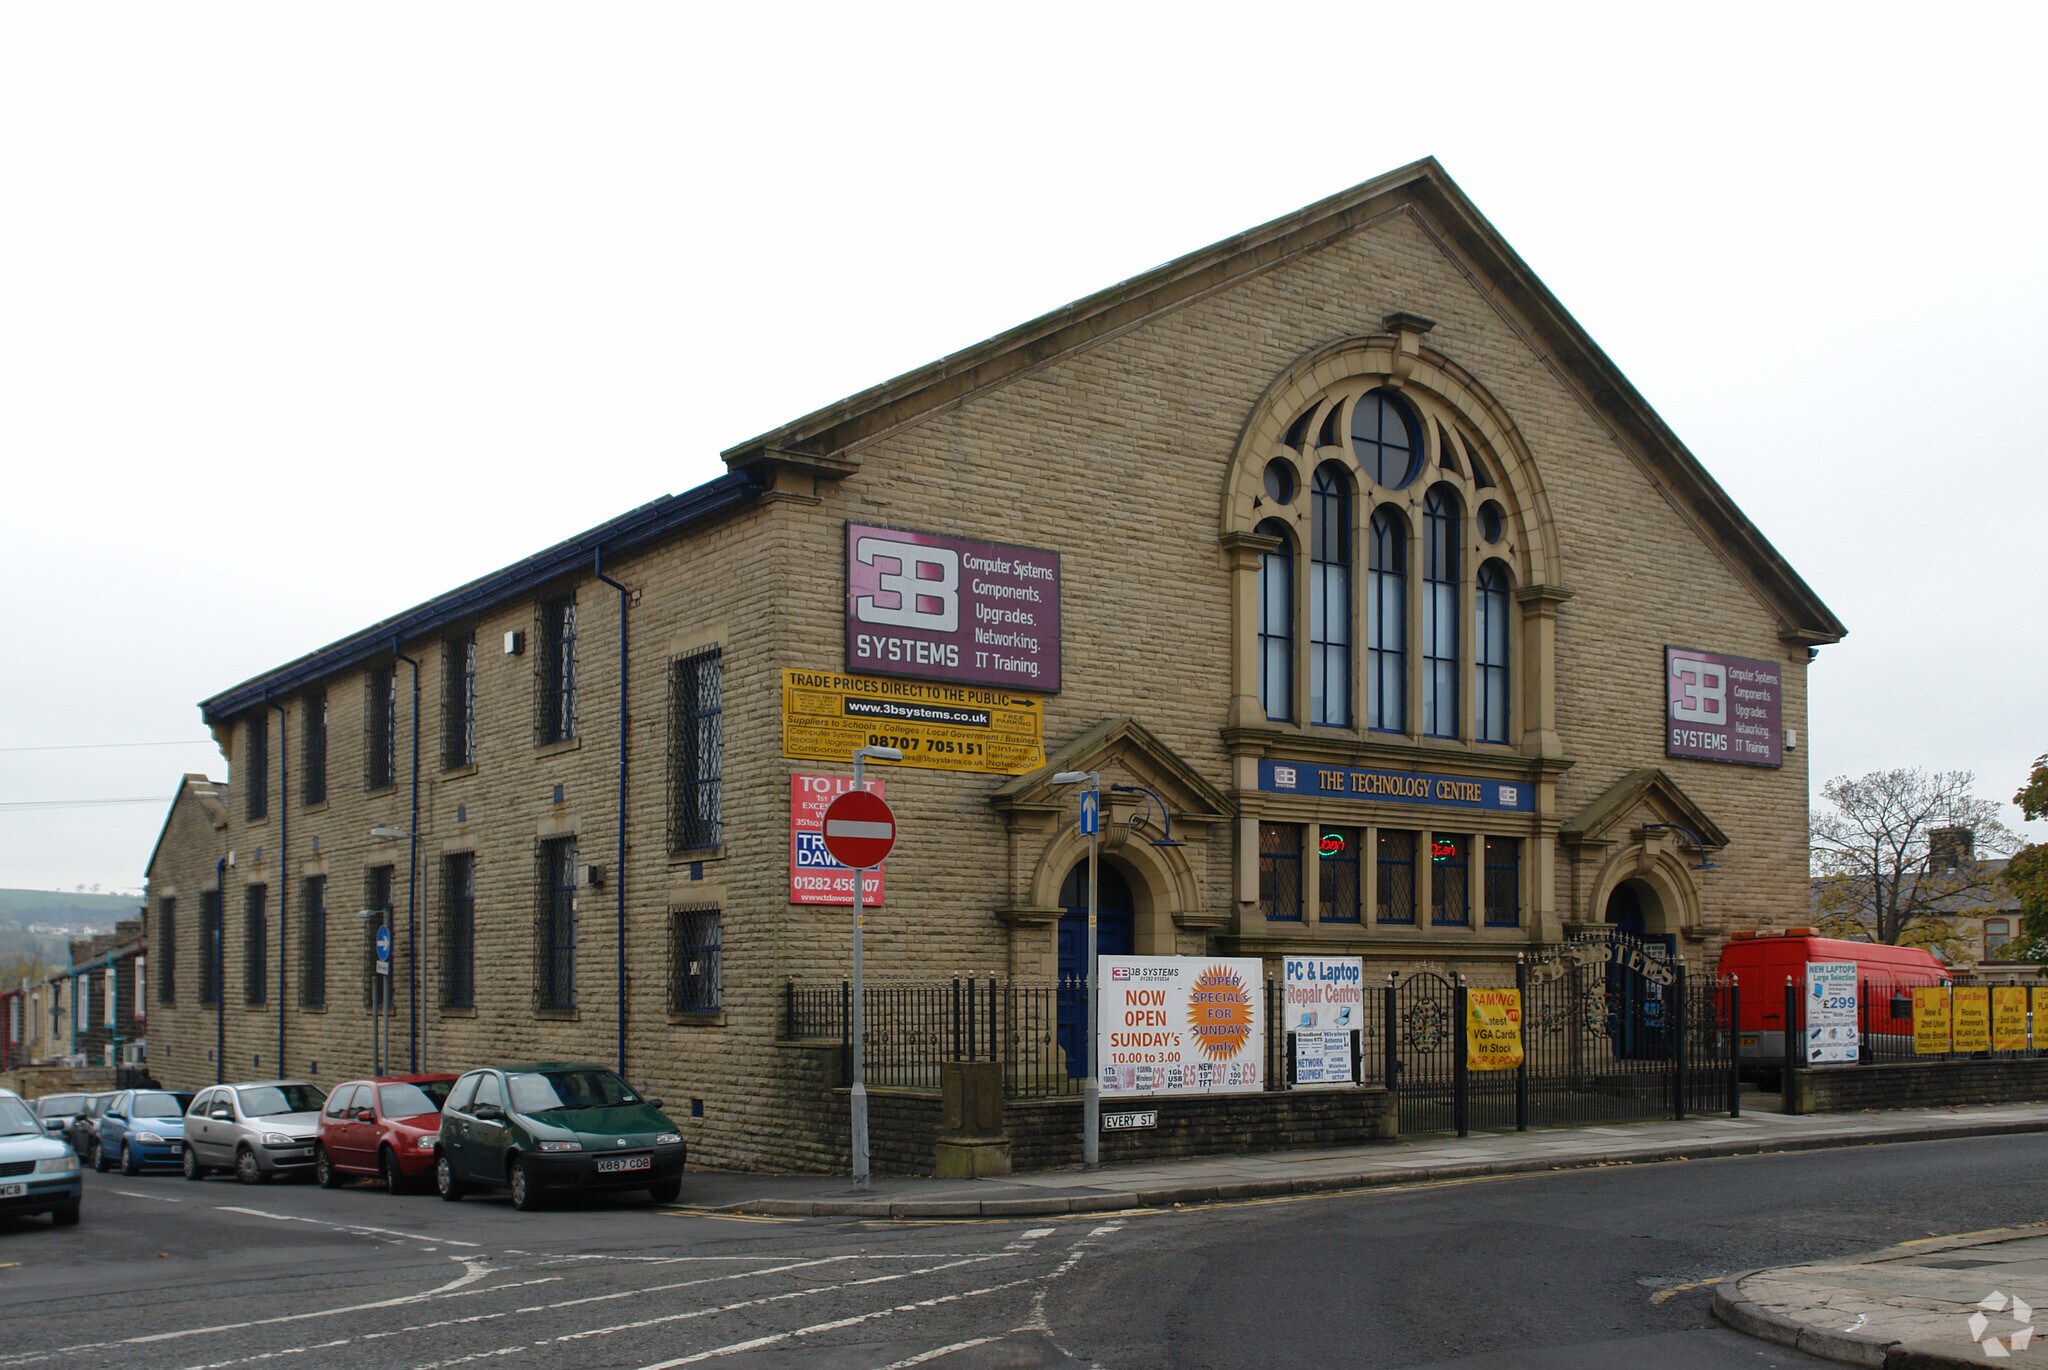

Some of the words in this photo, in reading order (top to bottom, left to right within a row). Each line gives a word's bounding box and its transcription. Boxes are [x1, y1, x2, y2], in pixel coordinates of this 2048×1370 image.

[963, 552, 1011, 575] Computer
[1013, 560, 1055, 581] Systems.
[857, 536, 960, 633] 3B
[972, 578, 1042, 603] Components.
[976, 603, 1037, 626] Upgrades.
[975, 627, 1041, 654] Networking.
[857, 634, 959, 668] SYSTEMS
[975, 651, 989, 668] IT
[993, 653, 1041, 677] Training.
[1728, 666, 1754, 682] Computer
[789, 672, 831, 688] TRADE
[833, 677, 879, 693] PRICES
[881, 681, 923, 697] DIRECT
[926, 686, 940, 699] TO
[943, 688, 965, 702] THE
[968, 690, 1010, 706] PUBLIC
[1673, 657, 1727, 726] 3B
[849, 702, 987, 723] www.3bsystems.co.uk
[1735, 703, 1768, 719] Upgrades.
[787, 716, 828, 726] Suppliers
[831, 719, 840, 727] to
[842, 720, 876, 730] Schools
[884, 724, 919, 734] Colleges
[926, 728, 948, 736] Local
[950, 730, 999, 741] Government
[996, 718, 1032, 727] PARKING
[790, 728, 830, 736] Computer
[833, 731, 863, 739] Systems
[1673, 728, 1728, 751] SYSTEMS
[790, 744, 852, 754] Components
[868, 734, 919, 750] 08707
[926, 739, 982, 755] 705151
[1735, 739, 1743, 751] IT
[800, 777, 830, 793] TO
[1318, 769, 1345, 791] THE
[1350, 772, 1432, 798] TECHNOLOGY
[1436, 780, 1482, 802] CENTRE
[794, 876, 831, 890] 01282
[833, 878, 879, 892] 45807
[1572, 941, 1674, 986] SYSTEMS
[1809, 965, 1825, 973] NEW
[1826, 965, 1856, 973] LAPTOPS
[1130, 968, 1141, 976] 3B
[1143, 968, 1179, 977] SYSTEMS
[1287, 961, 1303, 981] PC
[1307, 961, 1316, 980] &
[1320, 961, 1359, 985] Laptop
[1813, 974, 1829, 982] Large
[1201, 976, 1240, 986] SUPER
[1125, 990, 1166, 1006] NOW
[1193, 992, 1248, 1003] SPECIAL's
[1287, 984, 1322, 1008] Repair
[1325, 983, 1360, 1003] Centre
[1472, 993, 1515, 1006] GAMING
[1823, 997, 1856, 1008] £299
[1208, 1008, 1232, 1019] FOR
[1924, 1008, 1936, 1016] New
[1485, 1017, 1507, 1025] Latest
[1921, 1020, 1932, 1028] 2nd
[1192, 1025, 1250, 1036] SUNDAY's
[1474, 1029, 1493, 1039] VGA
[1495, 1029, 1516, 1039] Cards
[1996, 1026, 2003, 1034] PC
[1110, 1032, 1180, 1048] SUNDAY's
[1209, 1041, 1234, 1054] only
[1479, 1044, 1487, 1052] In
[1490, 1043, 1512, 1053] Stock
[1112, 1052, 1142, 1064] 10.00
[1145, 1052, 1156, 1063] to
[1158, 1051, 1181, 1063] 3.00
[1298, 1058, 1323, 1067] NETWORK
[1489, 1056, 1495, 1065] &
[1104, 1067, 1115, 1075] 1Tb
[1199, 1063, 1212, 1071] NEW
[1242, 1063, 1256, 1084] £9
[1183, 1064, 1196, 1085] £5
[1212, 1064, 1227, 1084] £97
[1106, 1115, 1135, 1127] EVERY
[600, 1161, 627, 1170] X887
[630, 1158, 650, 1168] CDB
